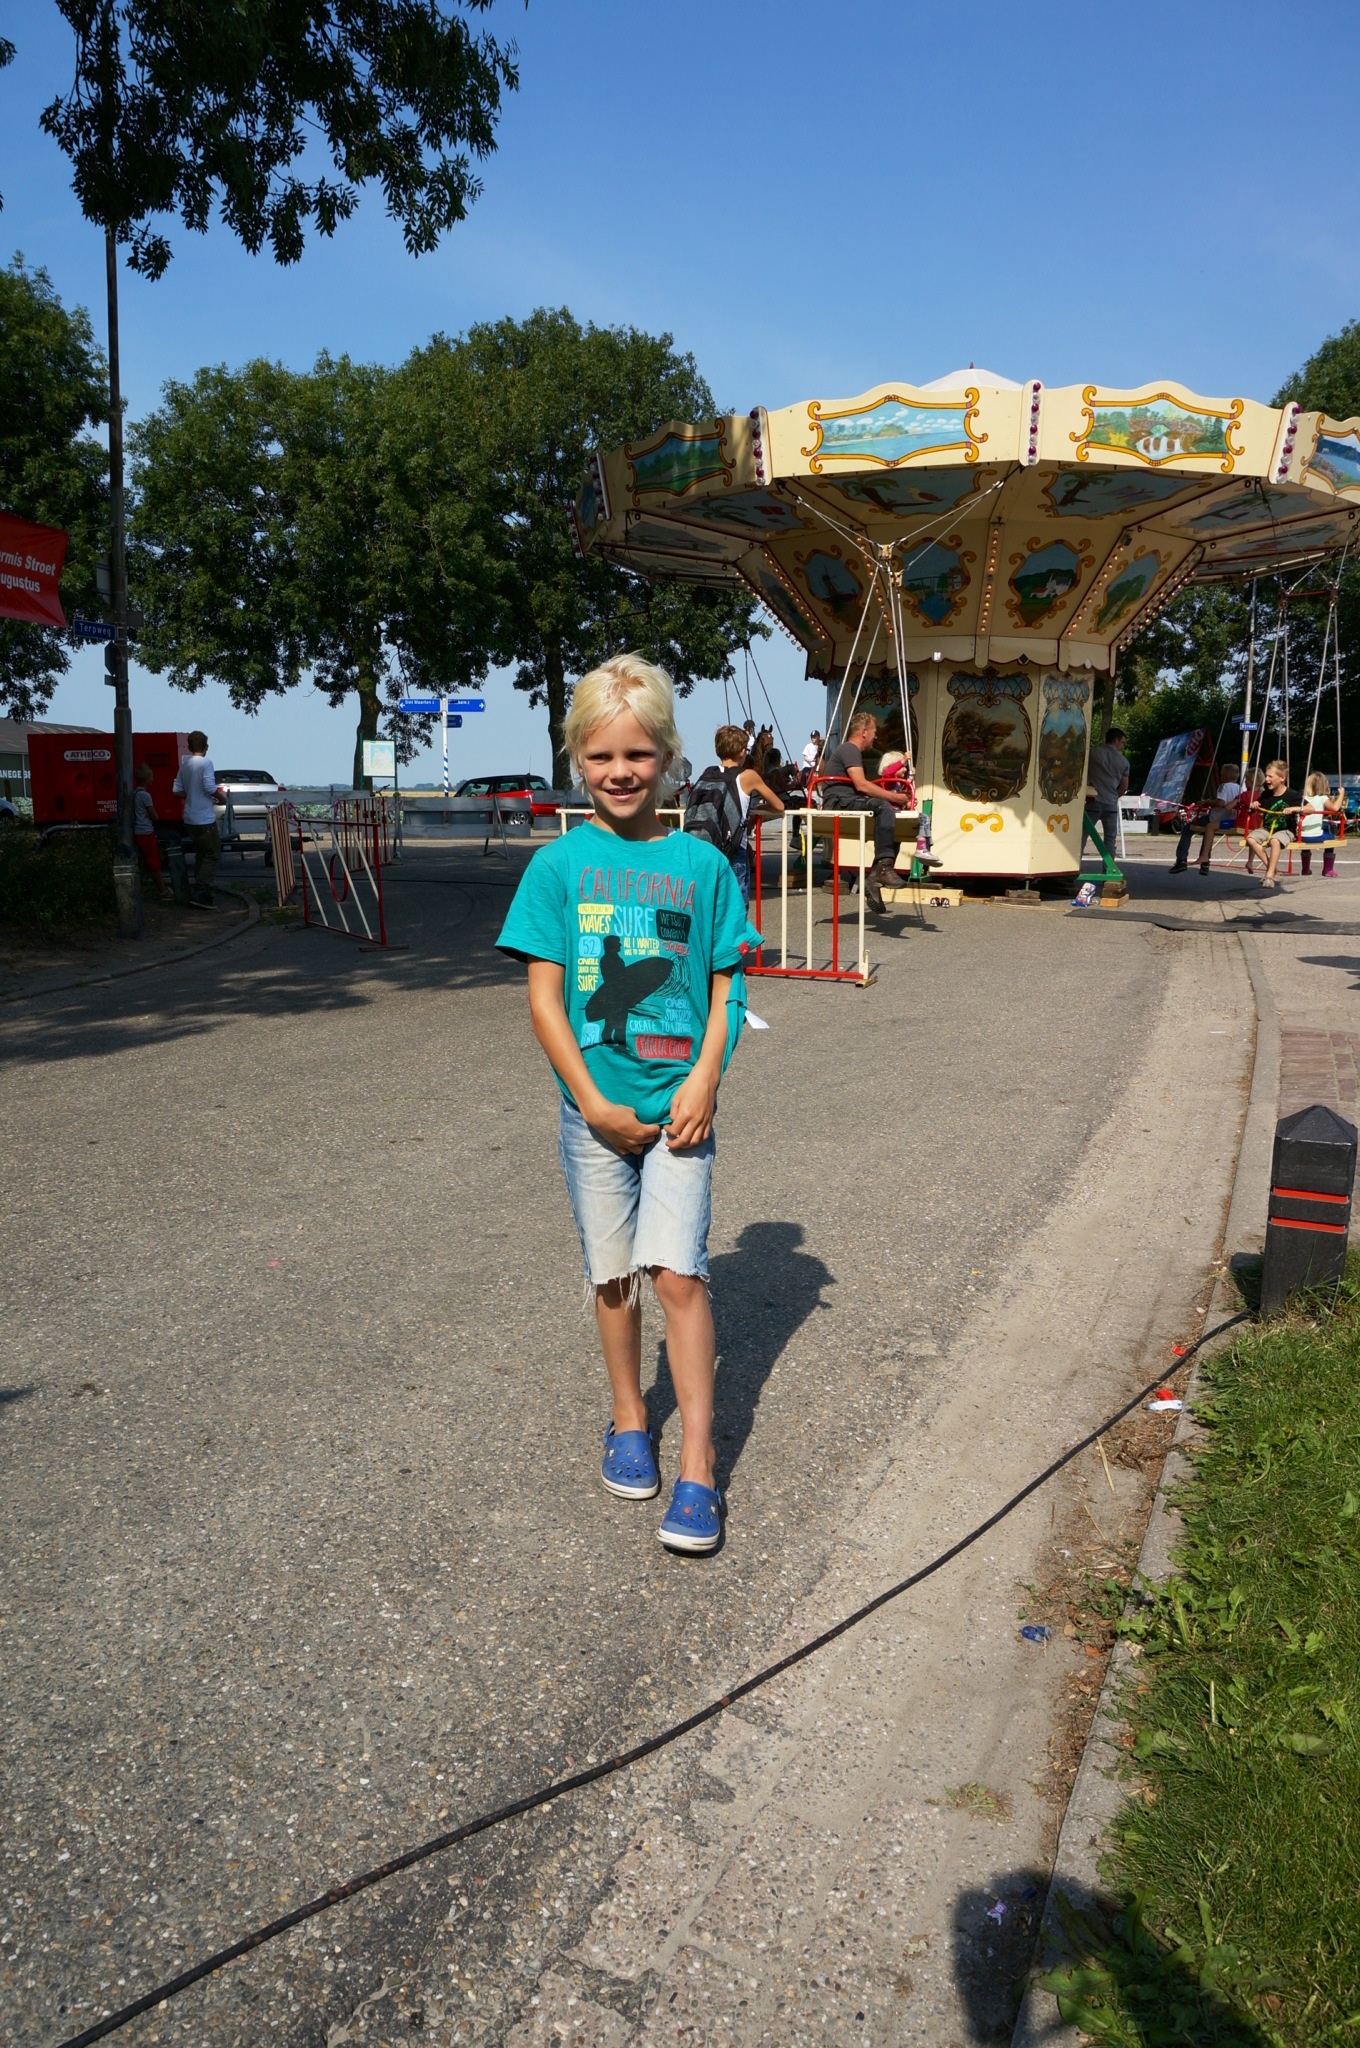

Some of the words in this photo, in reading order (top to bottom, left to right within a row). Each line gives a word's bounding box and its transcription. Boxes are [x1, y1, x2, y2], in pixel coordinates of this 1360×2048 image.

[25, 555, 56, 576] Stroet
[79, 622, 111, 638] Terpweg
[579, 866, 696, 916] CALIFORNIA
[578, 914, 611, 934] WAVES
[614, 905, 655, 937] SURF
[582, 939, 598, 955] 52
[623, 937, 631, 948] ALL
[636, 937, 660, 950] WANTED
[577, 974, 599, 992] SURF
[629, 1020, 657, 1032] CREATE
[660, 1020, 670, 1033] TO
